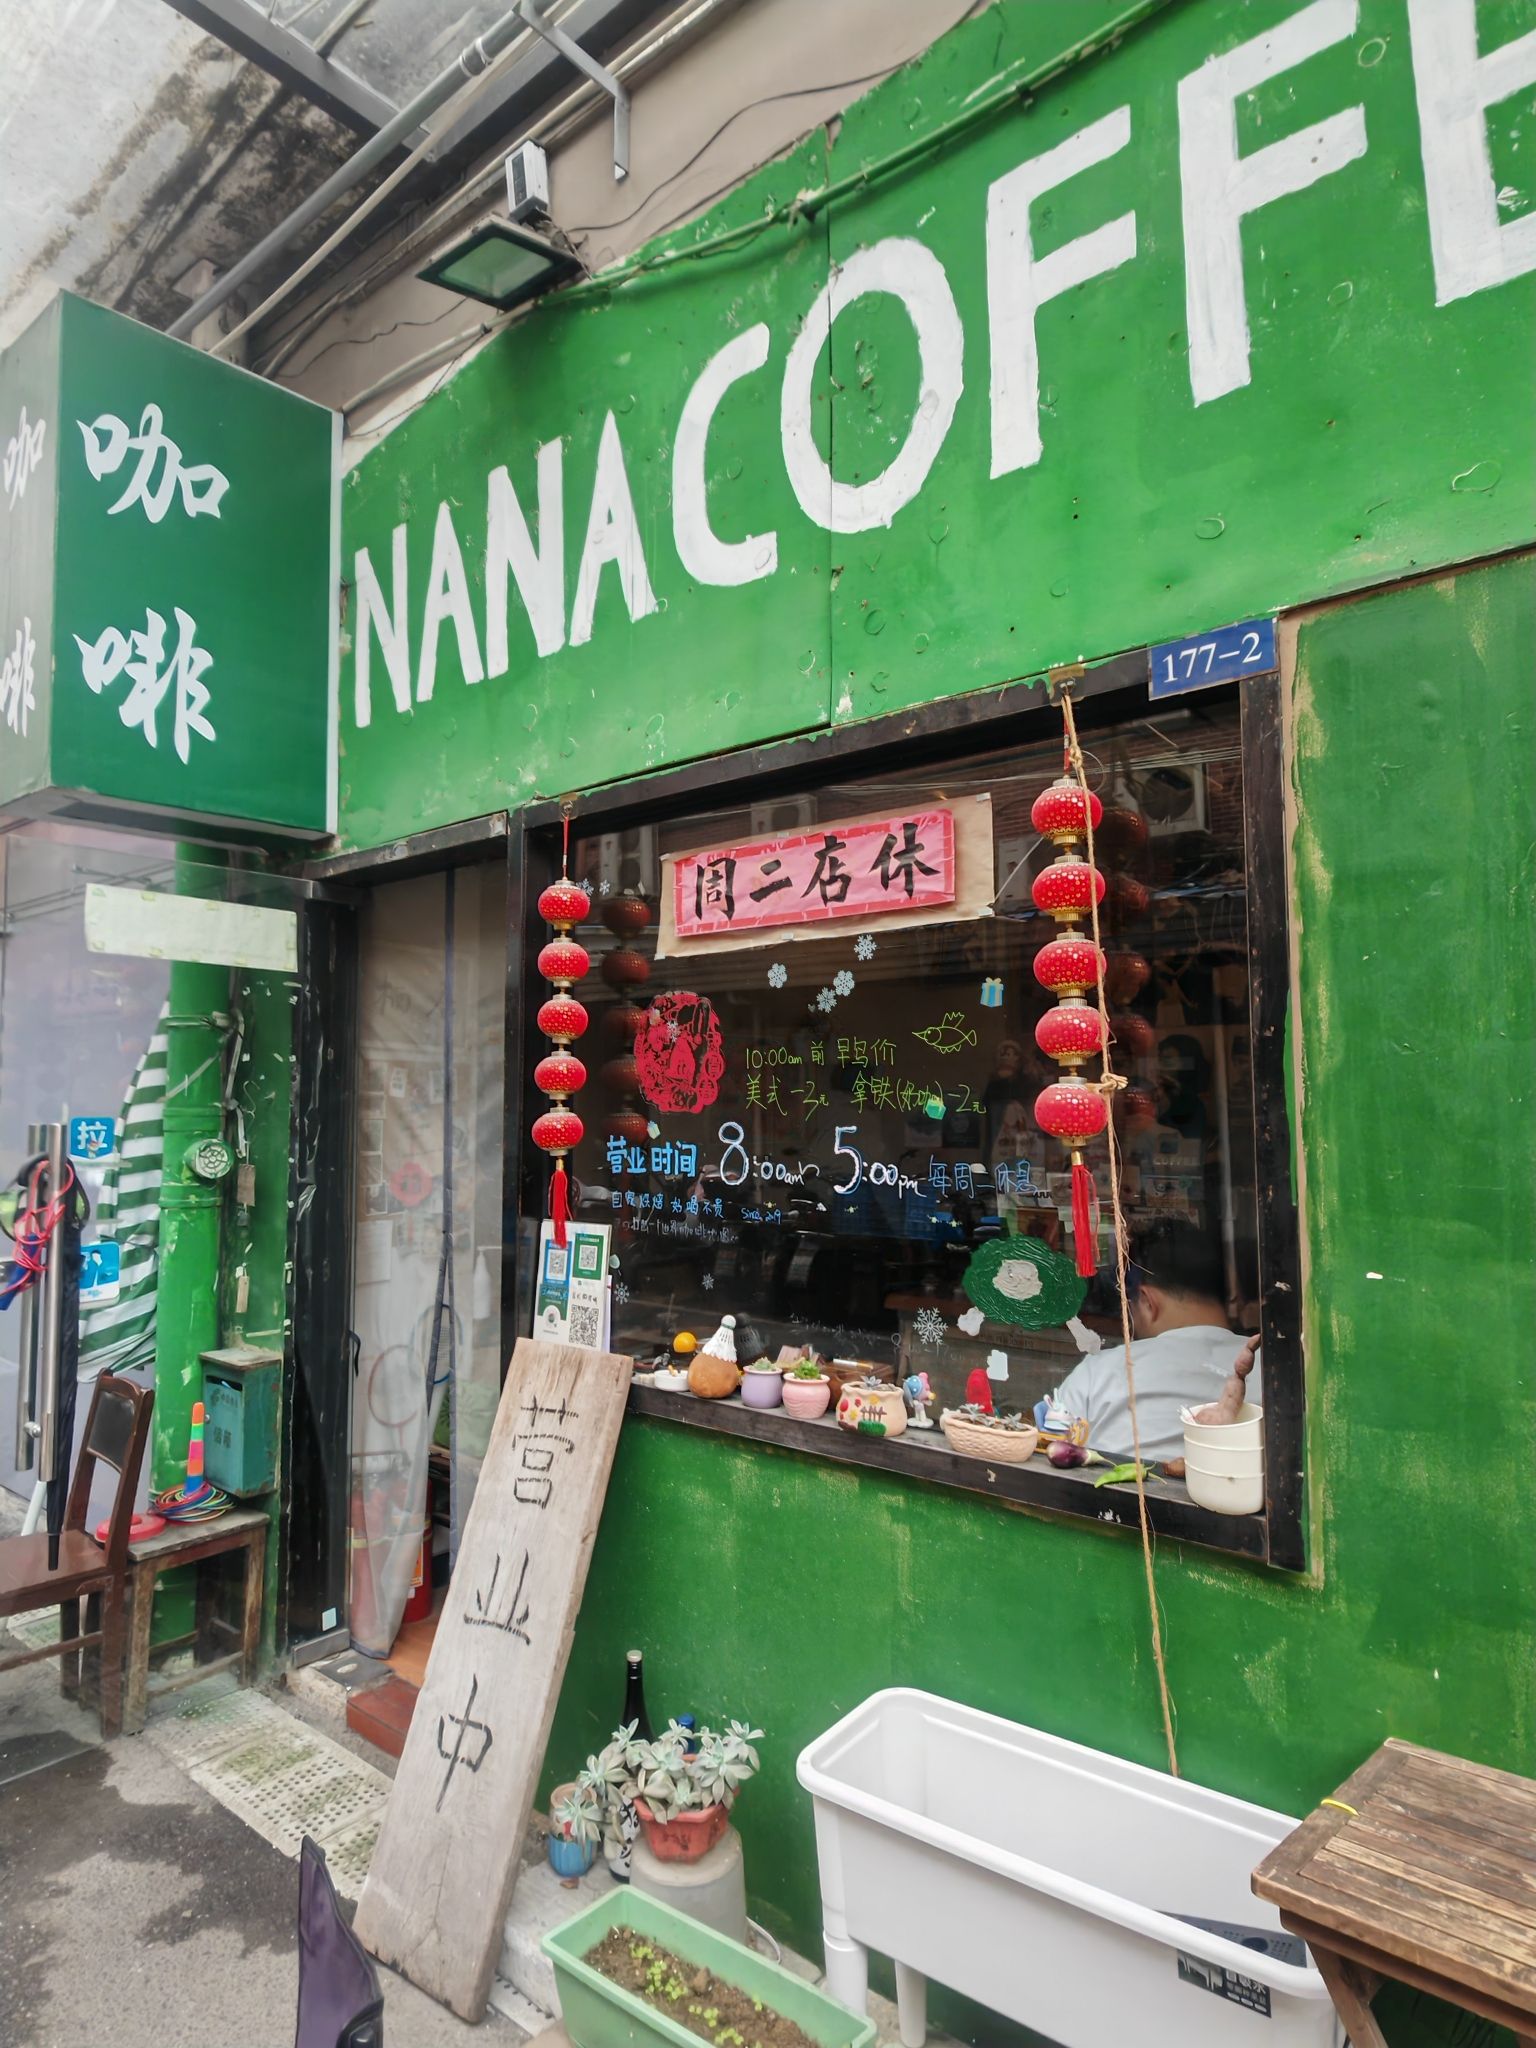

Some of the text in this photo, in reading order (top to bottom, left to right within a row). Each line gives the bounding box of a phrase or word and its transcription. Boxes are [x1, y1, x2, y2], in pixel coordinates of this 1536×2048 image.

[72, 402, 230, 765] 咖啡
[1162, 632, 1263, 683] 177-2
[695, 822, 941, 921] 周二店休
[746, 1047, 803, 1070] 10:00am
[836, 1037, 897, 1069] 早鸟价
[606, 1134, 698, 1179] 营业时间
[928, 1154, 1039, 1199] 每周二休息
[670, 1194, 725, 1219] 好喝不贵
[436, 1394, 579, 1813] 营业中
